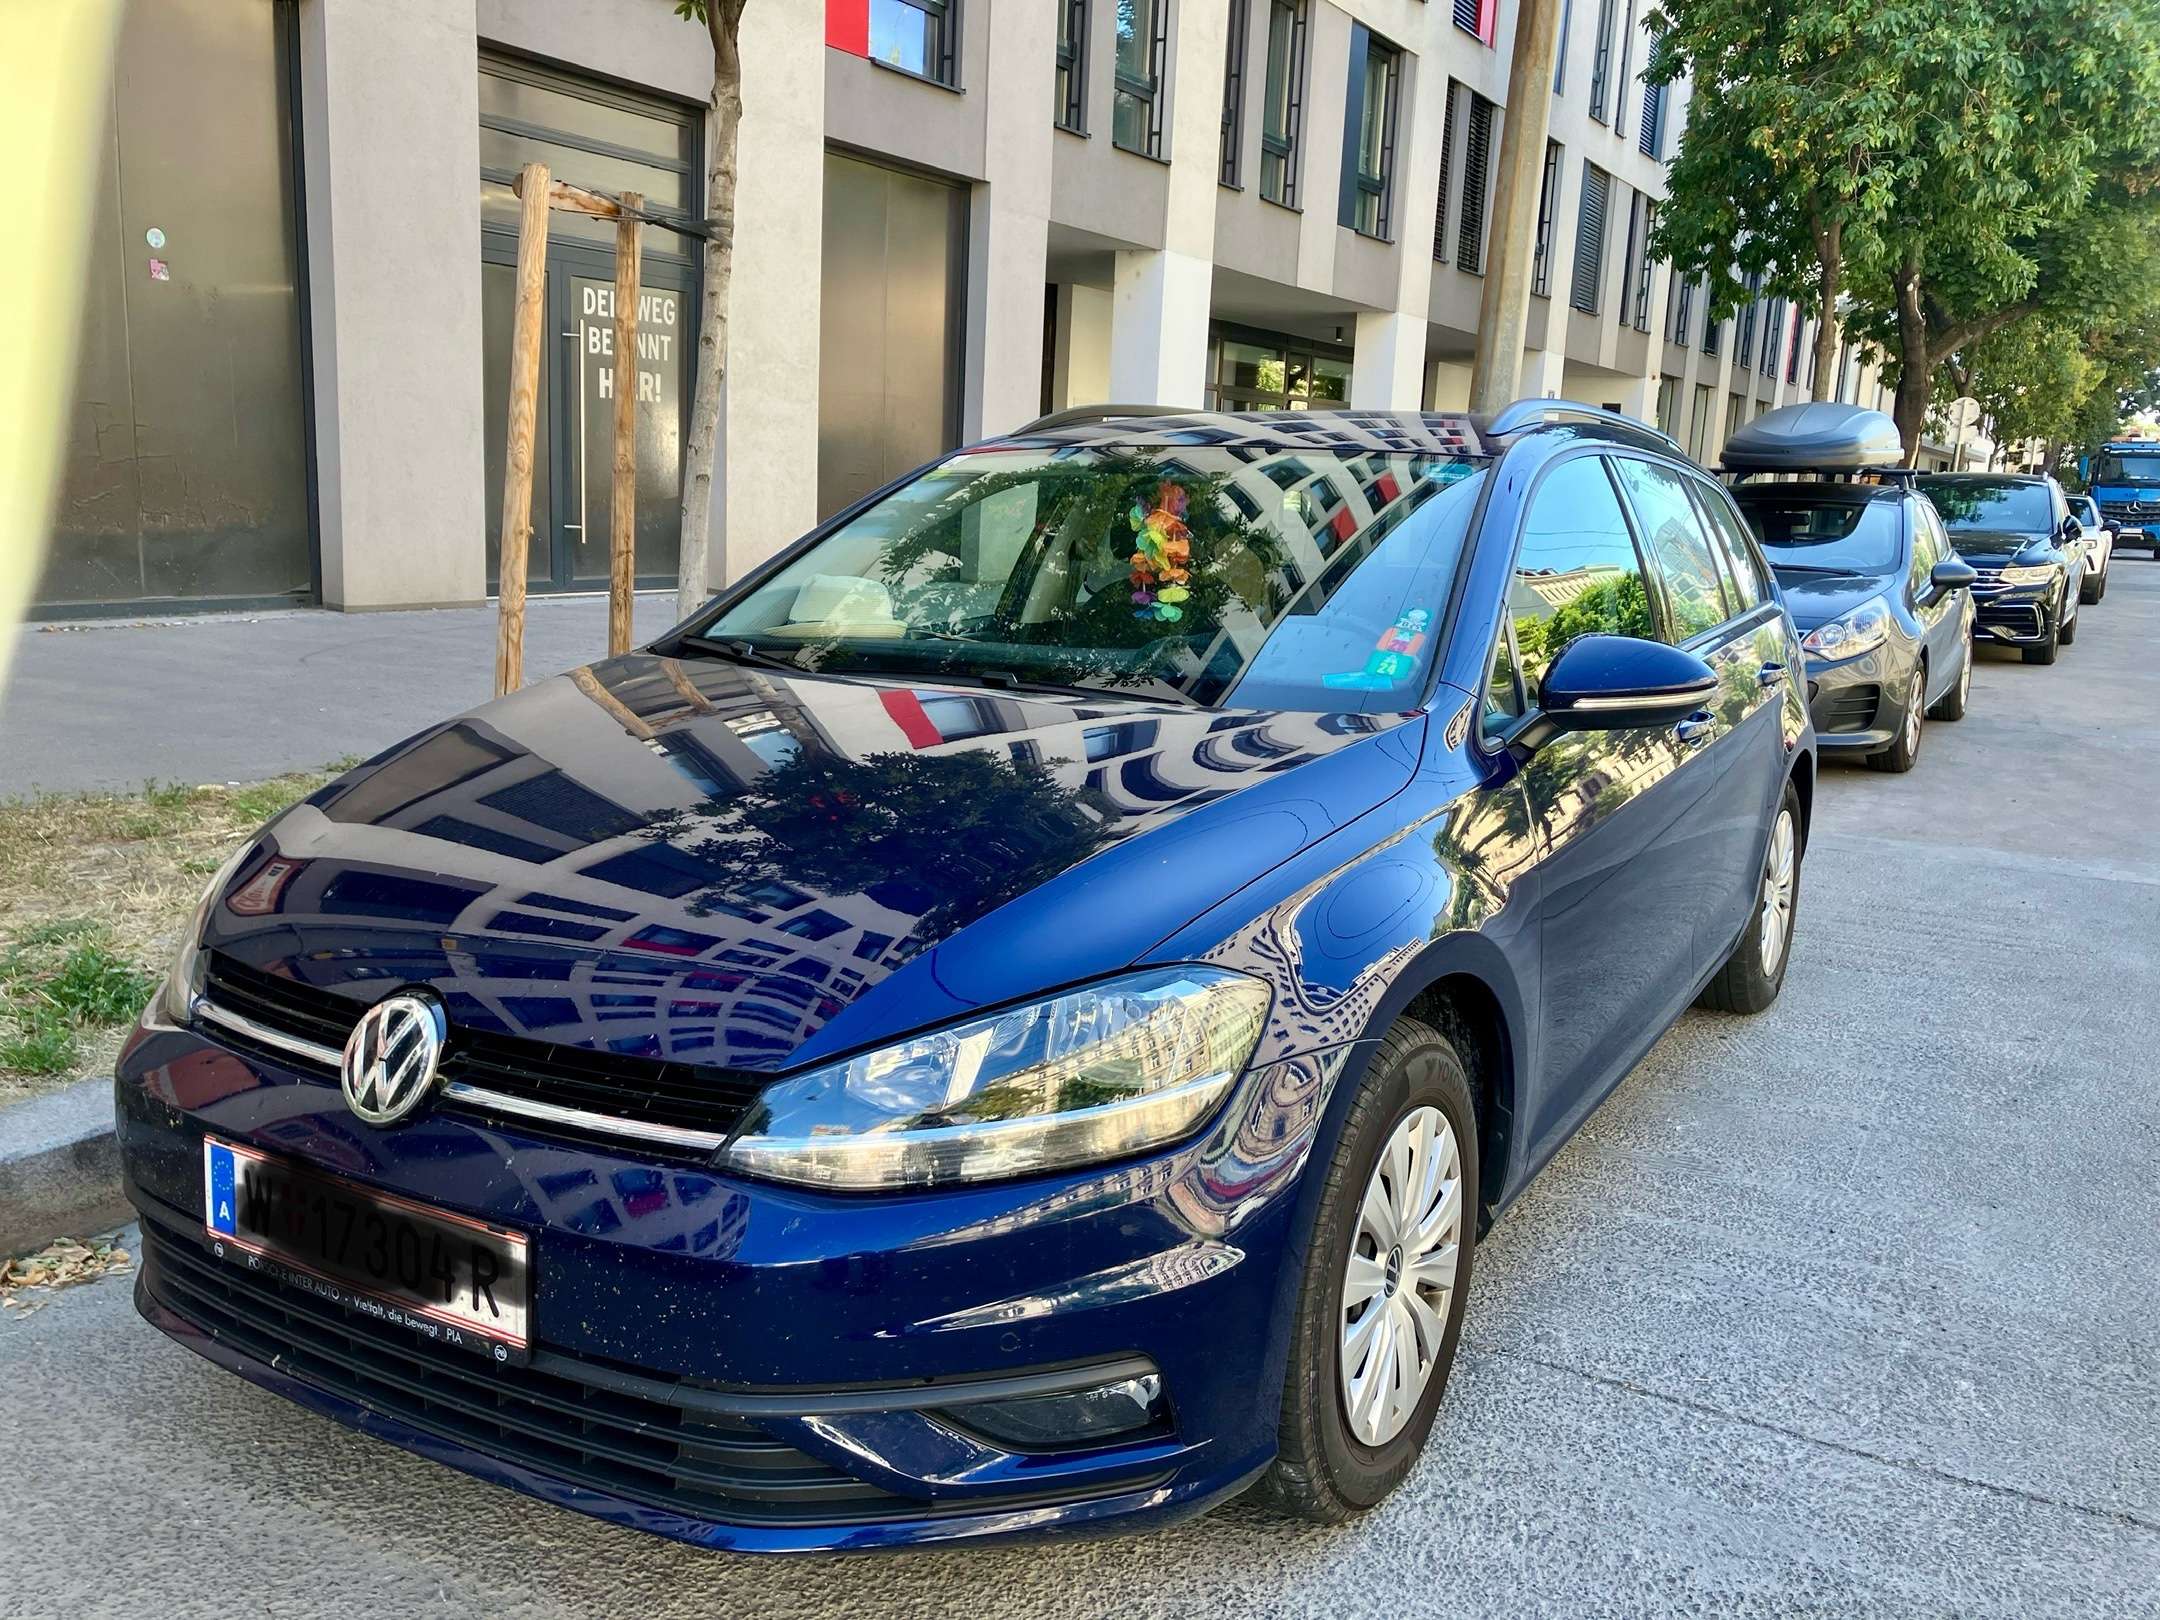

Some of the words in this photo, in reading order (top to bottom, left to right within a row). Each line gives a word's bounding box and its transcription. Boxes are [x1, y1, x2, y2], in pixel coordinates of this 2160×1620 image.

[583, 287, 615, 318] DEI
[588, 326, 671, 361] BENNT
[599, 367, 662, 403] HR!
[218, 1200, 232, 1222] A
[314, 1281, 341, 1301] AUTO
[388, 1308, 403, 1324] die
[446, 1327, 463, 1345] PIA
